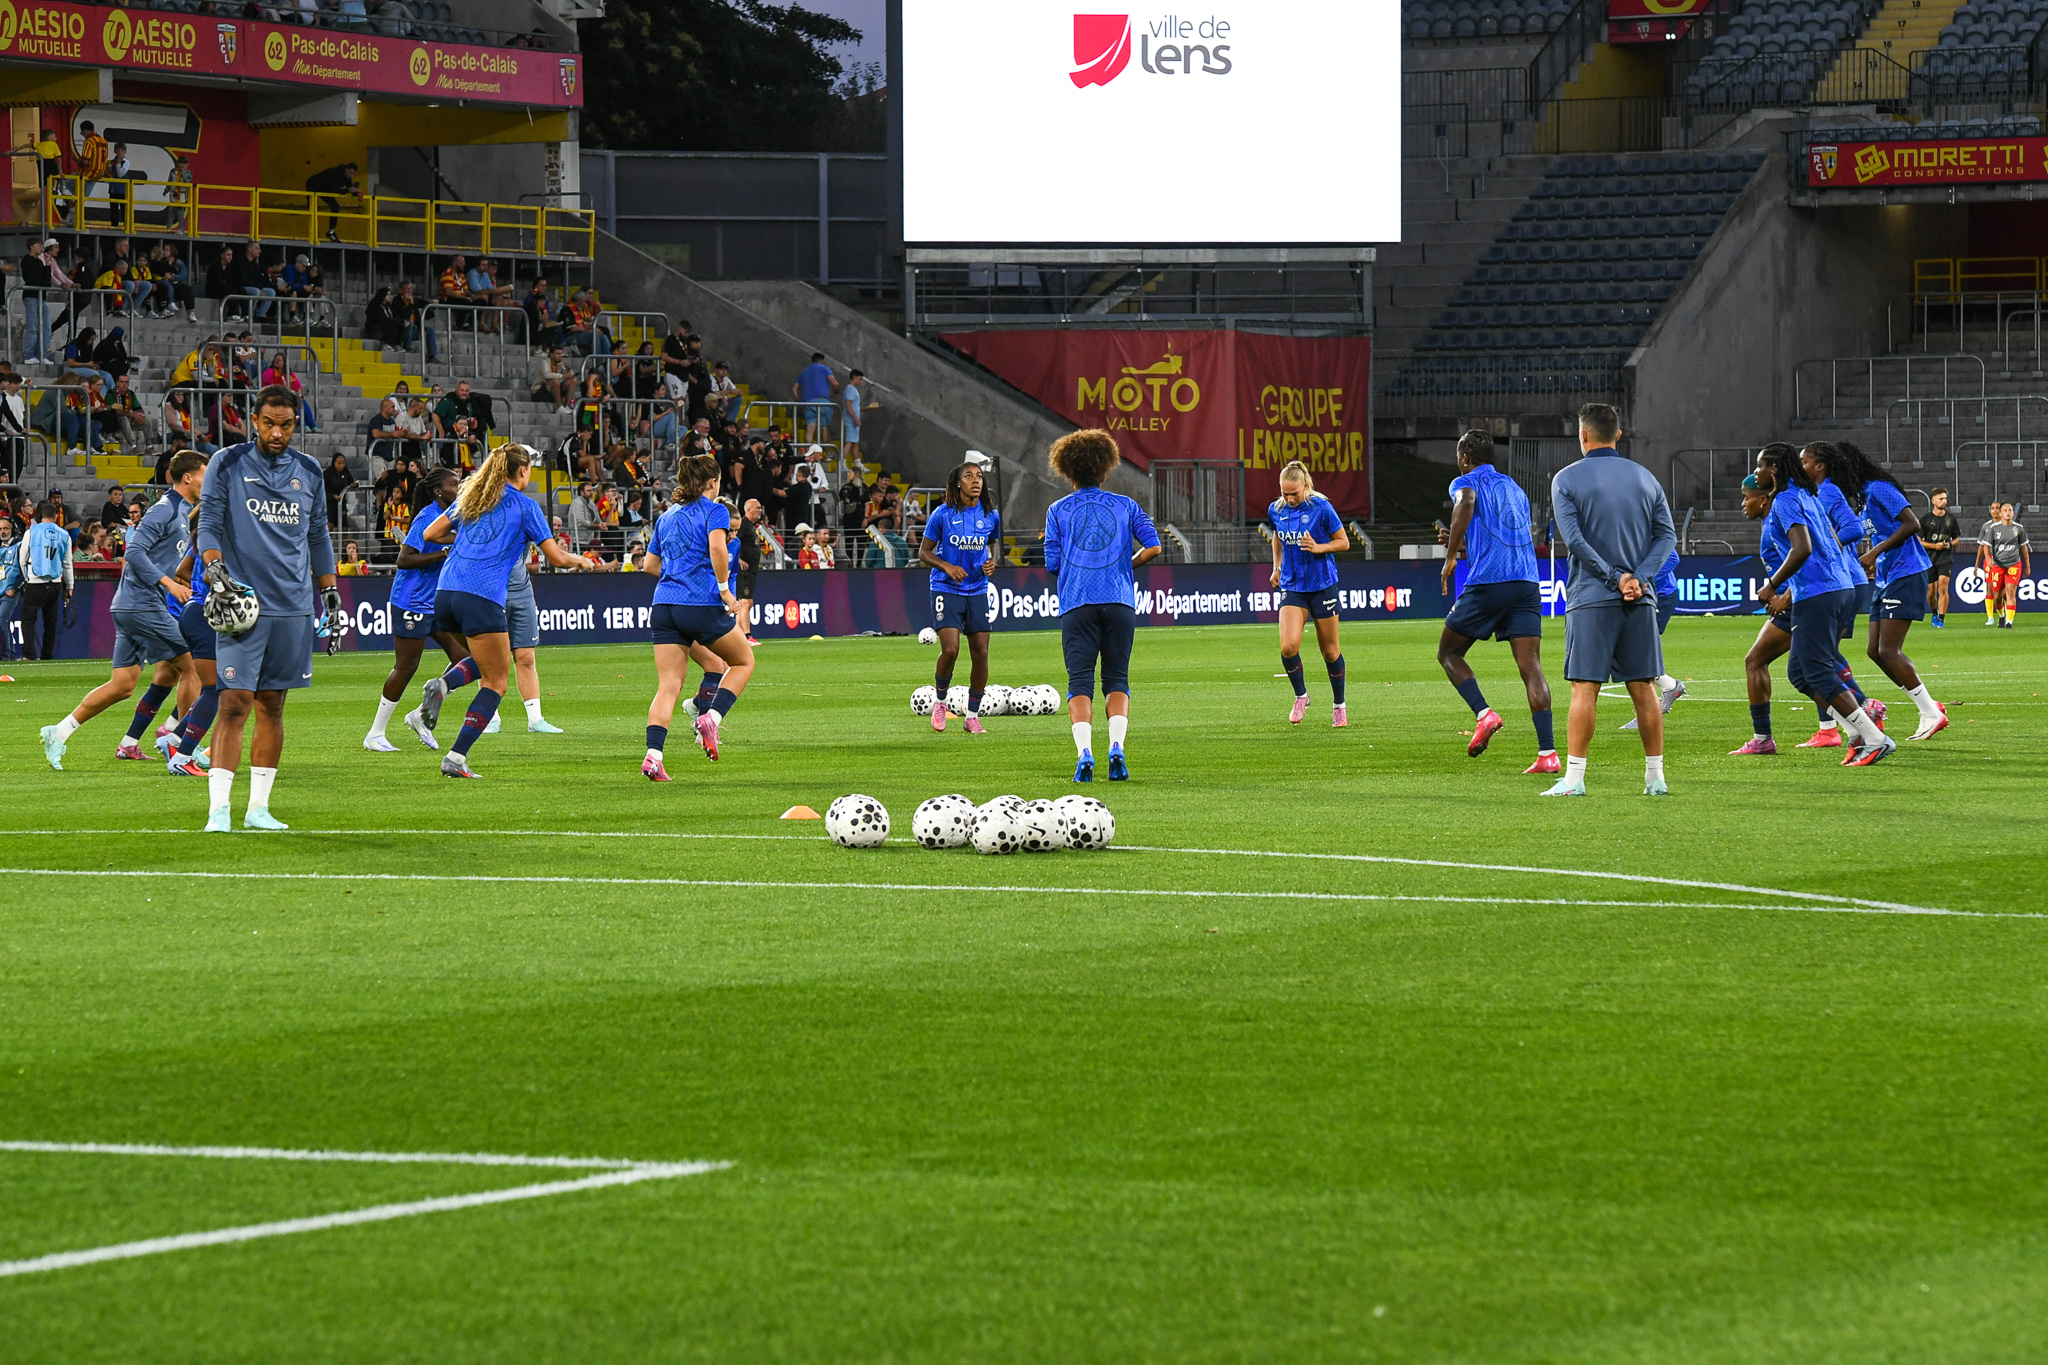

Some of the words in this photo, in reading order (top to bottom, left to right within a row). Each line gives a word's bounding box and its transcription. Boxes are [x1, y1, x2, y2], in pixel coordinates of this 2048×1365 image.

[19, 8, 85, 40] AÉSIO
[1149, 14, 1194, 39] ville
[1198, 15, 1231, 39] de
[133, 19, 196, 50] AÉSIO
[19, 38, 82, 58] MUTUELLE
[132, 49, 193, 67] MUTUELLE
[268, 41, 283, 61] 62
[1141, 34, 1233, 75] lens
[292, 58, 312, 75] Mon
[313, 64, 361, 80] Département
[412, 57, 427, 76] 62
[435, 73, 454, 89] Mon
[454, 78, 501, 93] Département
[1893, 145, 2024, 168] MORETTI
[1893, 166, 2025, 178] CONSTRUCTIONS
[1077, 376, 1200, 412] MOTO
[1261, 384, 1343, 427] GROUPE
[1106, 416, 1171, 431] VALLEY
[1239, 428, 1364, 472] LEMPEREUR
[246, 498, 300, 516] QATAR
[1062, 494, 1118, 513] PARIS
[259, 513, 300, 525] AIRWAYS
[949, 534, 986, 546] QATAR
[44, 545, 58, 561] TV
[1961, 577, 1984, 593] 62
[935, 595, 945, 613] 6
[1155, 588, 1242, 620] Département
[1247, 591, 1272, 612] 1ER
[1350, 589, 1367, 609] DU
[603, 606, 635, 630] 1ER
